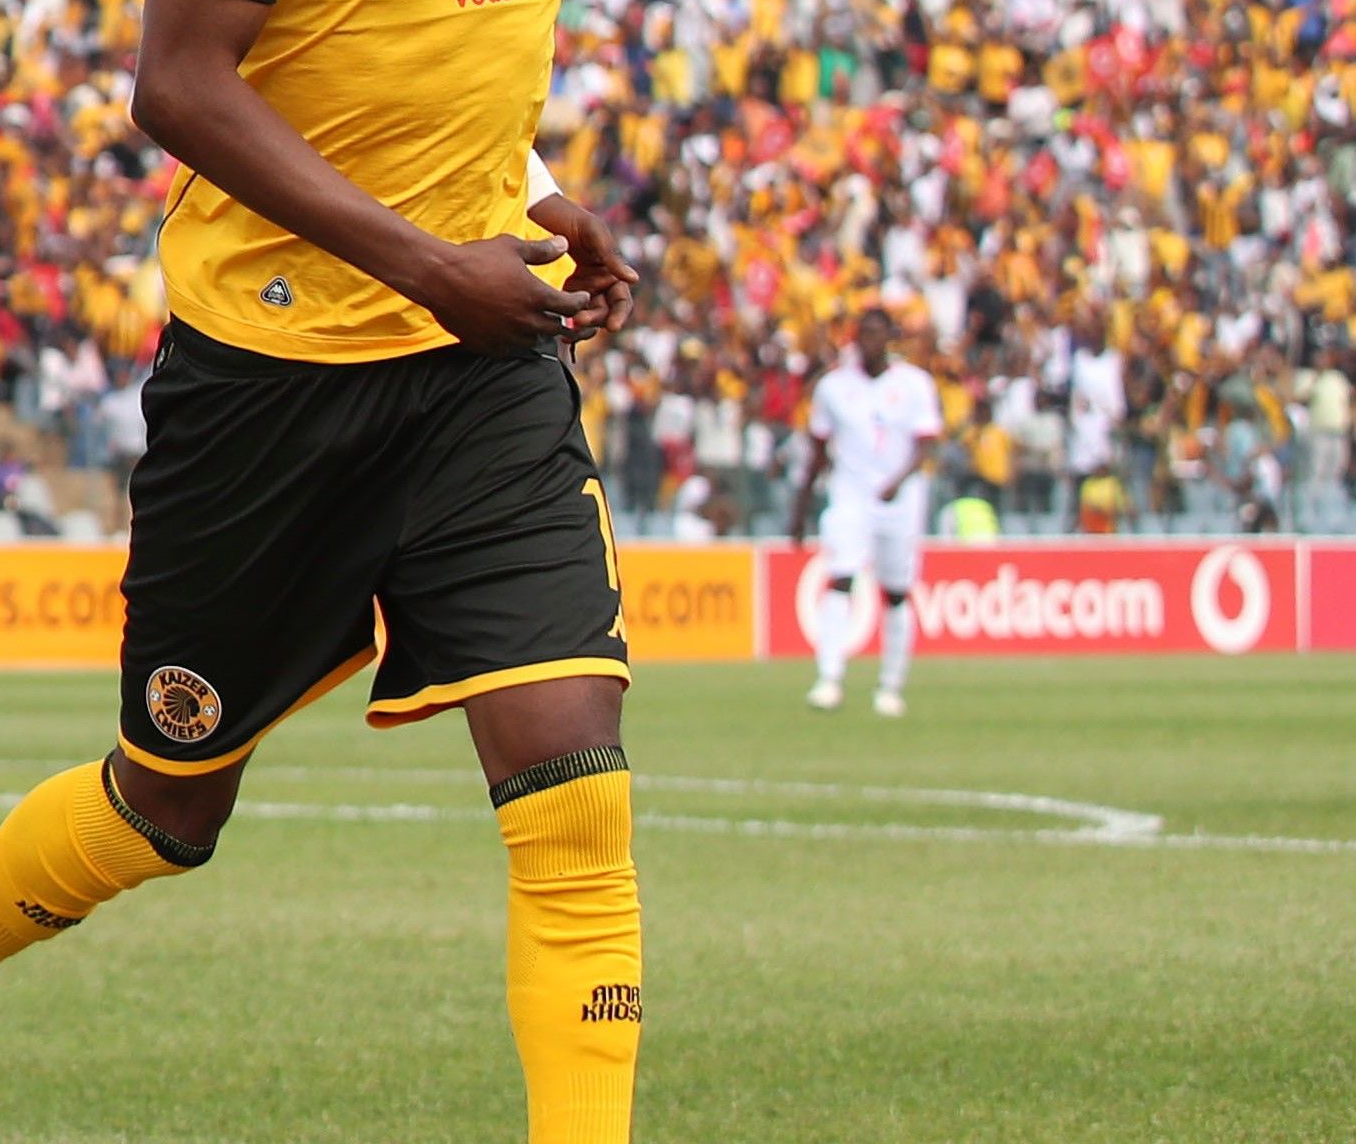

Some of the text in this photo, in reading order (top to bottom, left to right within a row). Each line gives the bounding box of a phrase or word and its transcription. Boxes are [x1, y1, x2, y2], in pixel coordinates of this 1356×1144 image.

[911, 562, 1165, 639] vodacom
[158, 671, 208, 699] KAIZER
[155, 708, 207, 738] CHIEFS
